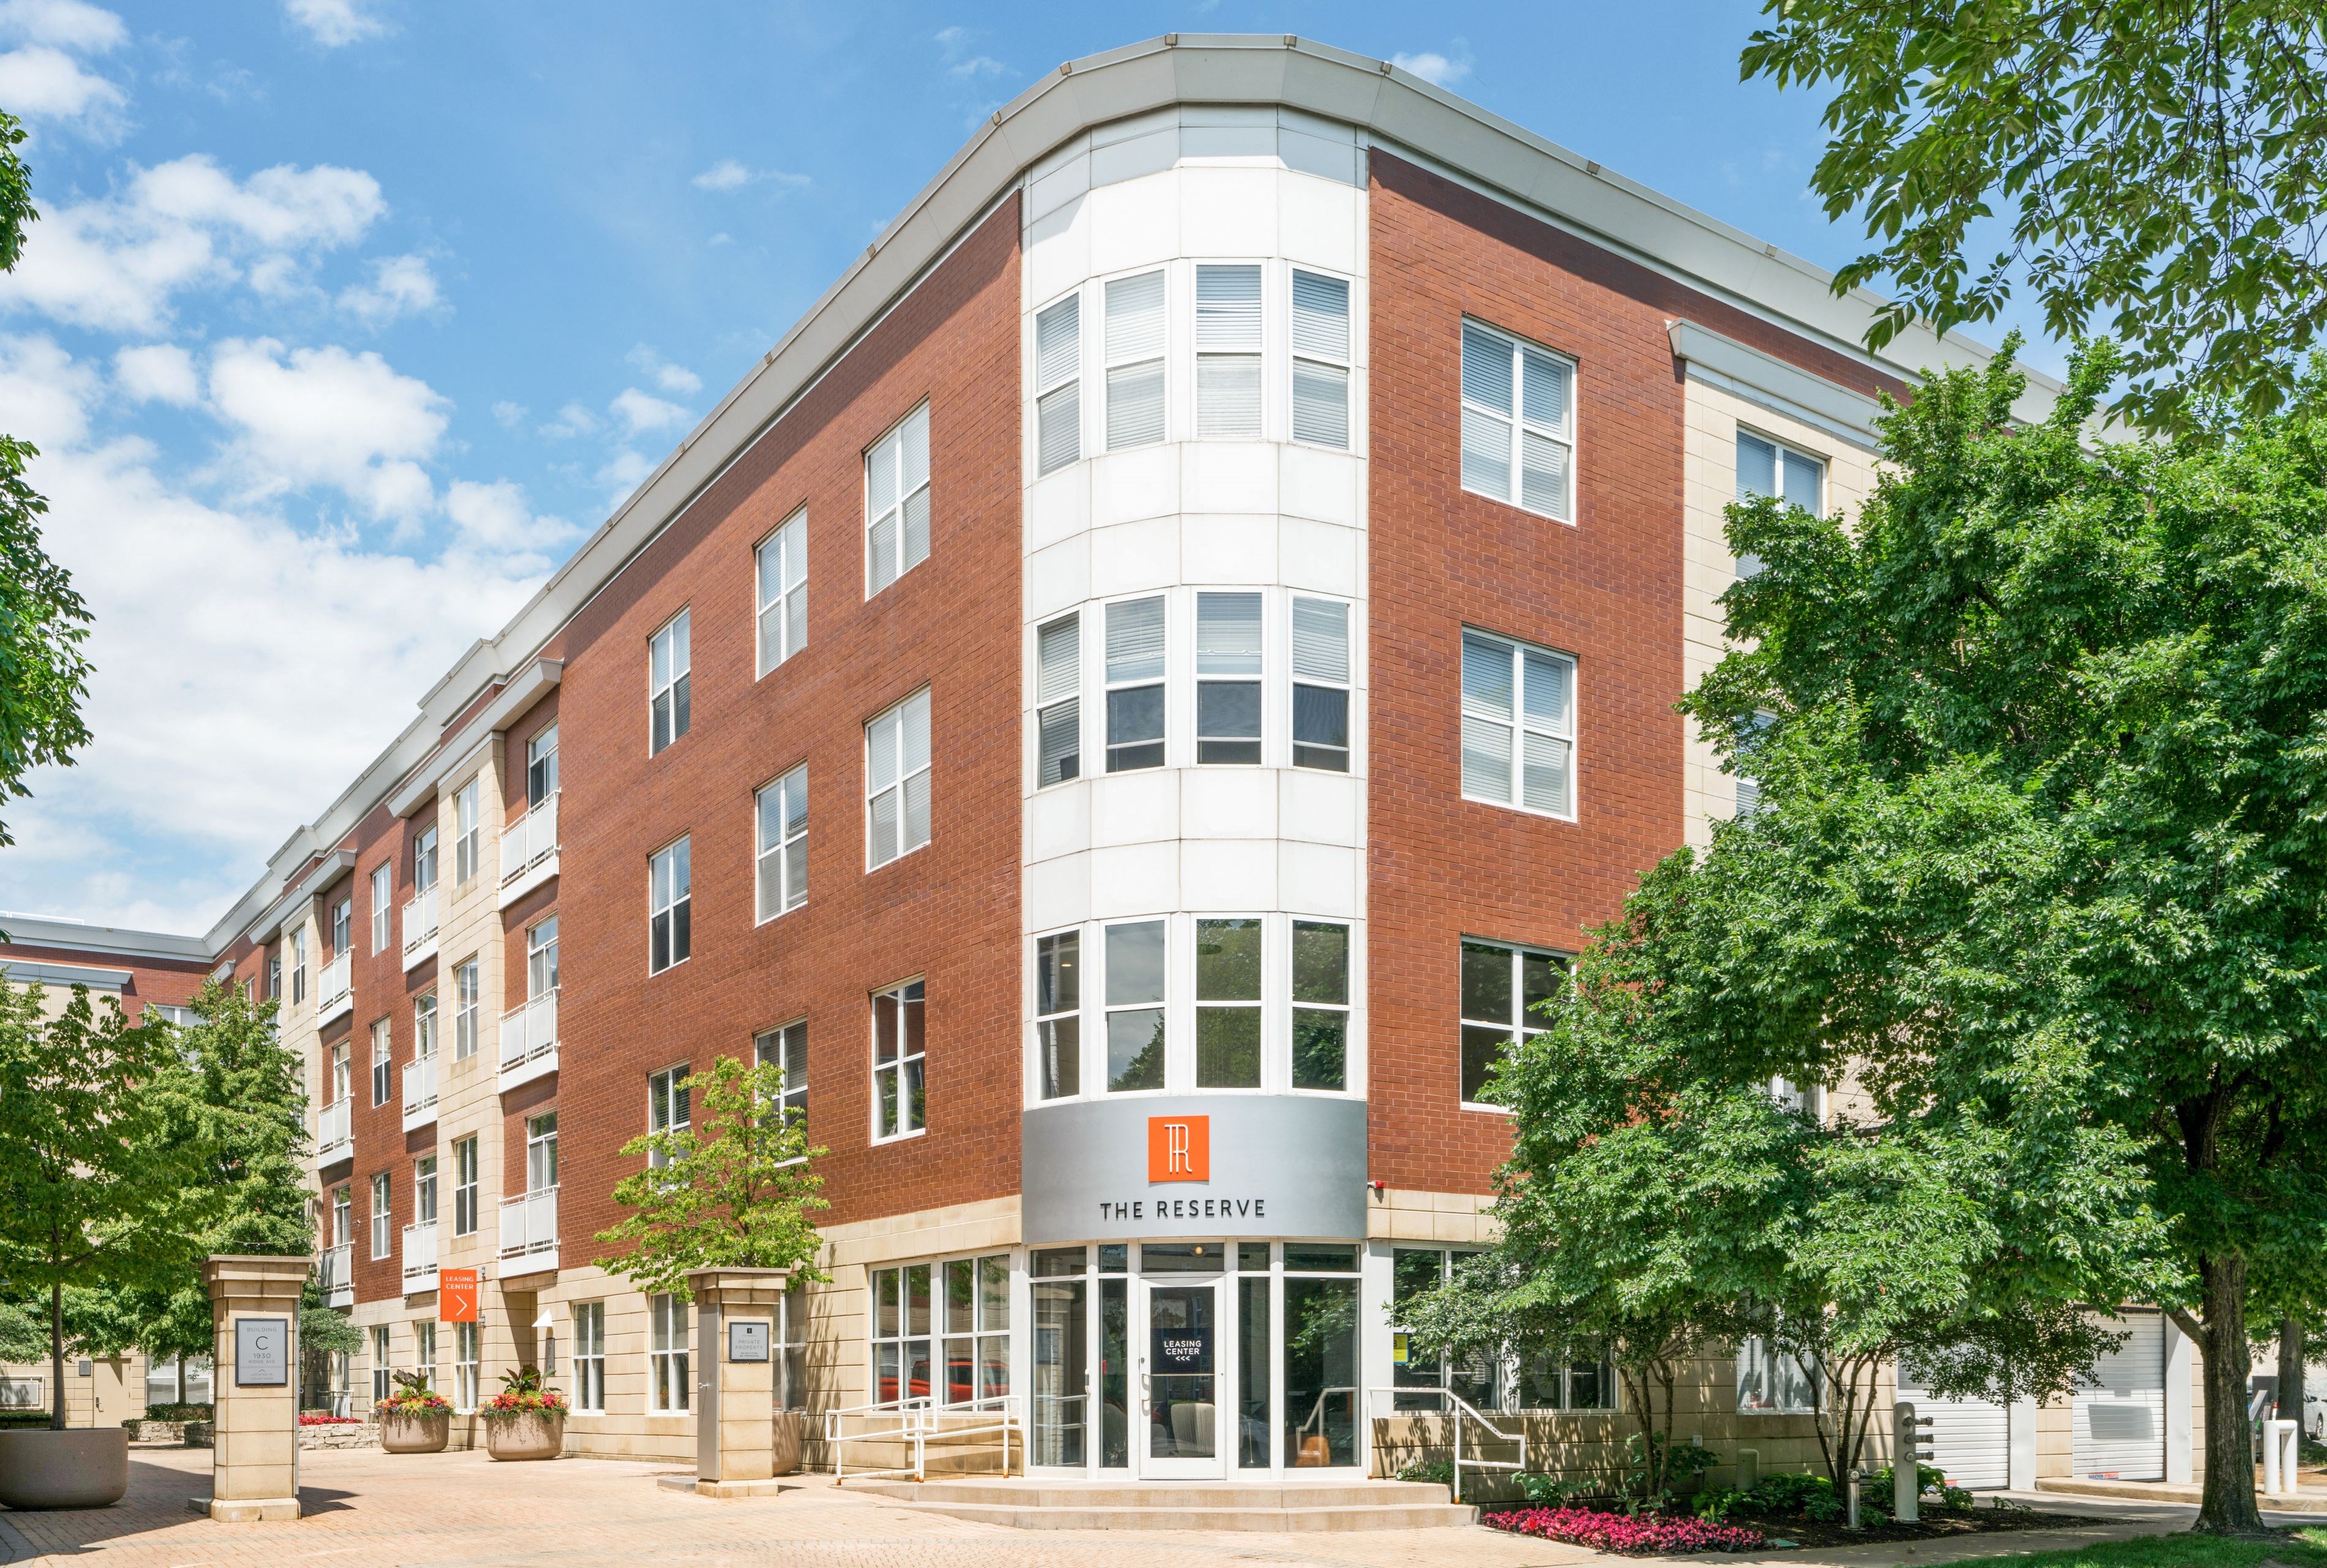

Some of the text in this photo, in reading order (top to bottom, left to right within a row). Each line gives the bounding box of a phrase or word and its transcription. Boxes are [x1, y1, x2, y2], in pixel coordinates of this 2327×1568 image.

[1100, 1199, 1265, 1221] THE RESERVE
[255, 1336, 268, 1350] C
